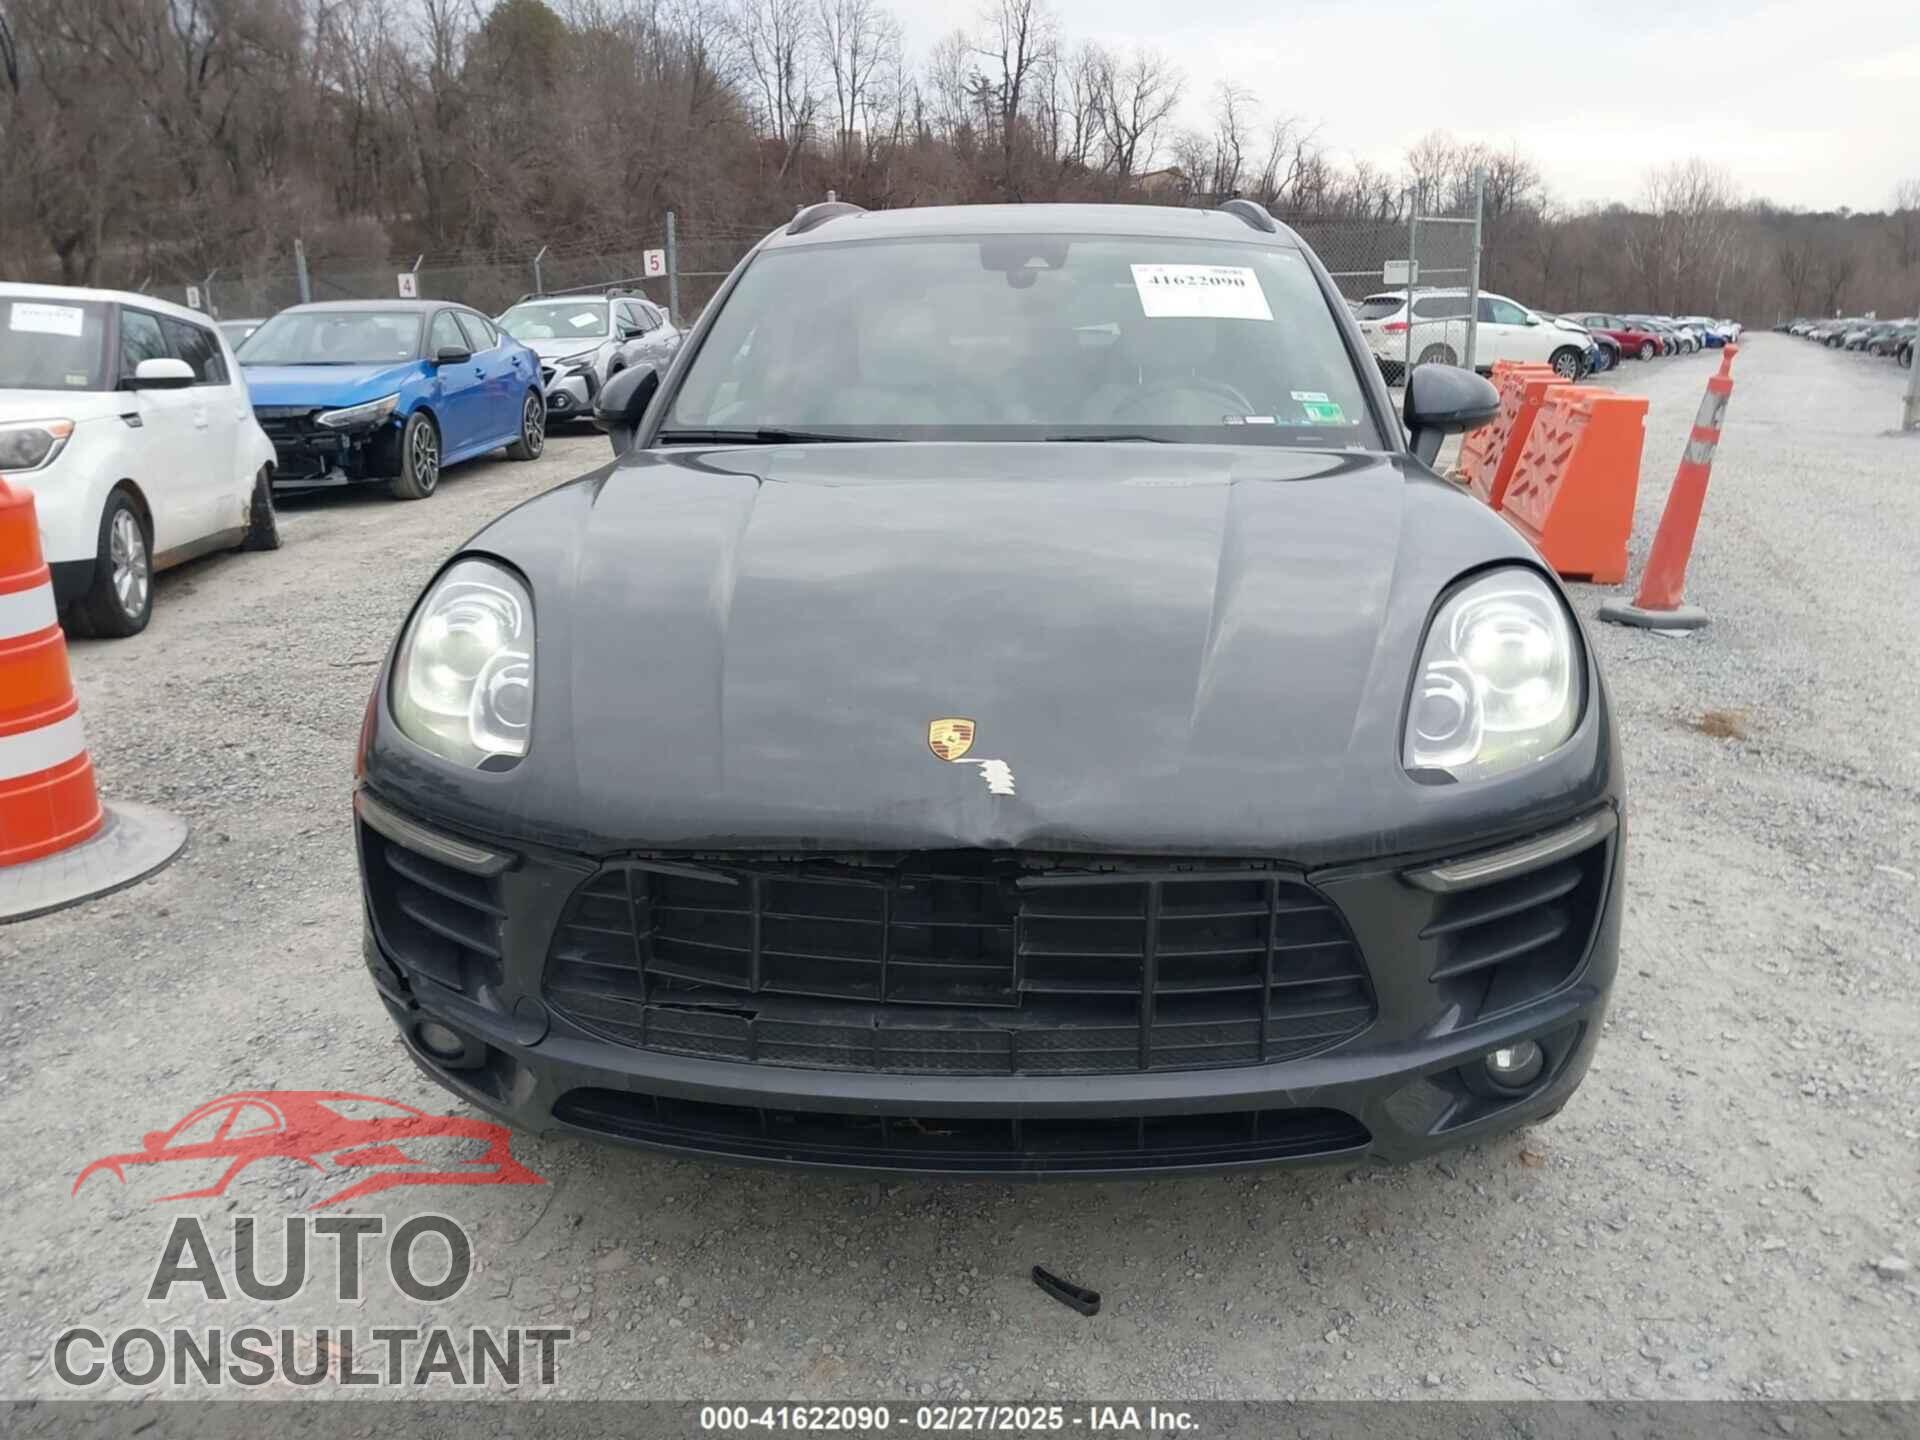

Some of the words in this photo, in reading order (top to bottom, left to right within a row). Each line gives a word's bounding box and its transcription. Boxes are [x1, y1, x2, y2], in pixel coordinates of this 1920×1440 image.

[650, 254, 660, 272] 5
[403, 278, 411, 292] 4
[1149, 275, 1246, 287] 41622090
